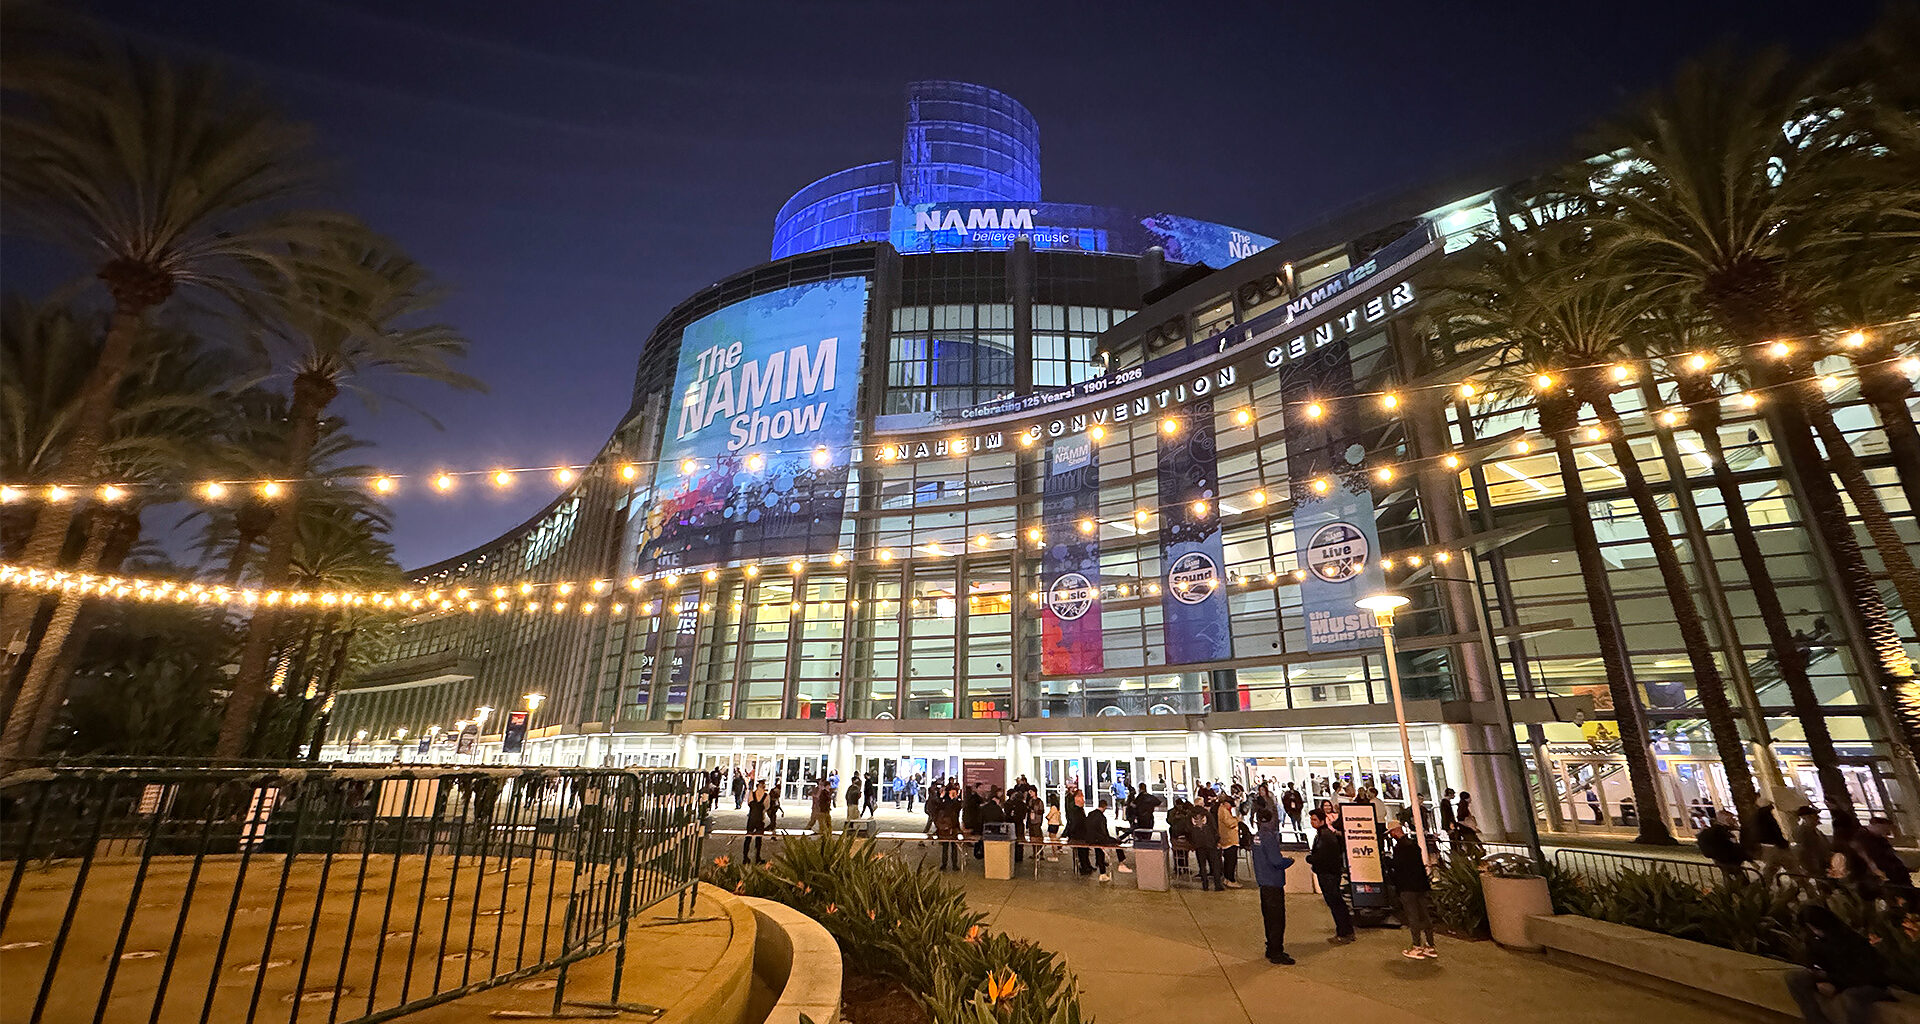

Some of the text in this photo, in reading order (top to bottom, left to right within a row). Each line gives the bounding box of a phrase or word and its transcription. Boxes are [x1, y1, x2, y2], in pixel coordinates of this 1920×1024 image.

[973, 231, 1015, 242] believe
[1033, 232, 1070, 243] music
[1231, 231, 1250, 244] The
[1287, 259, 1377, 315] NAMM 125
[697, 341, 743, 383] The
[875, 281, 1415, 460] ANAHEIM CONVENTION CENTER
[676, 337, 838, 440] NAMM
[961, 402, 1021, 419] Celebrating
[1022, 397, 1040, 408] 125
[1041, 388, 1076, 404] Years!
[727, 402, 828, 451] Show
[1055, 444, 1088, 464] NAMM
[1322, 545, 1352, 559] Live
[1174, 570, 1211, 585] Sound
[1055, 591, 1087, 601] Msic
[1309, 611, 1331, 620] the
[1311, 628, 1383, 644] begins her
